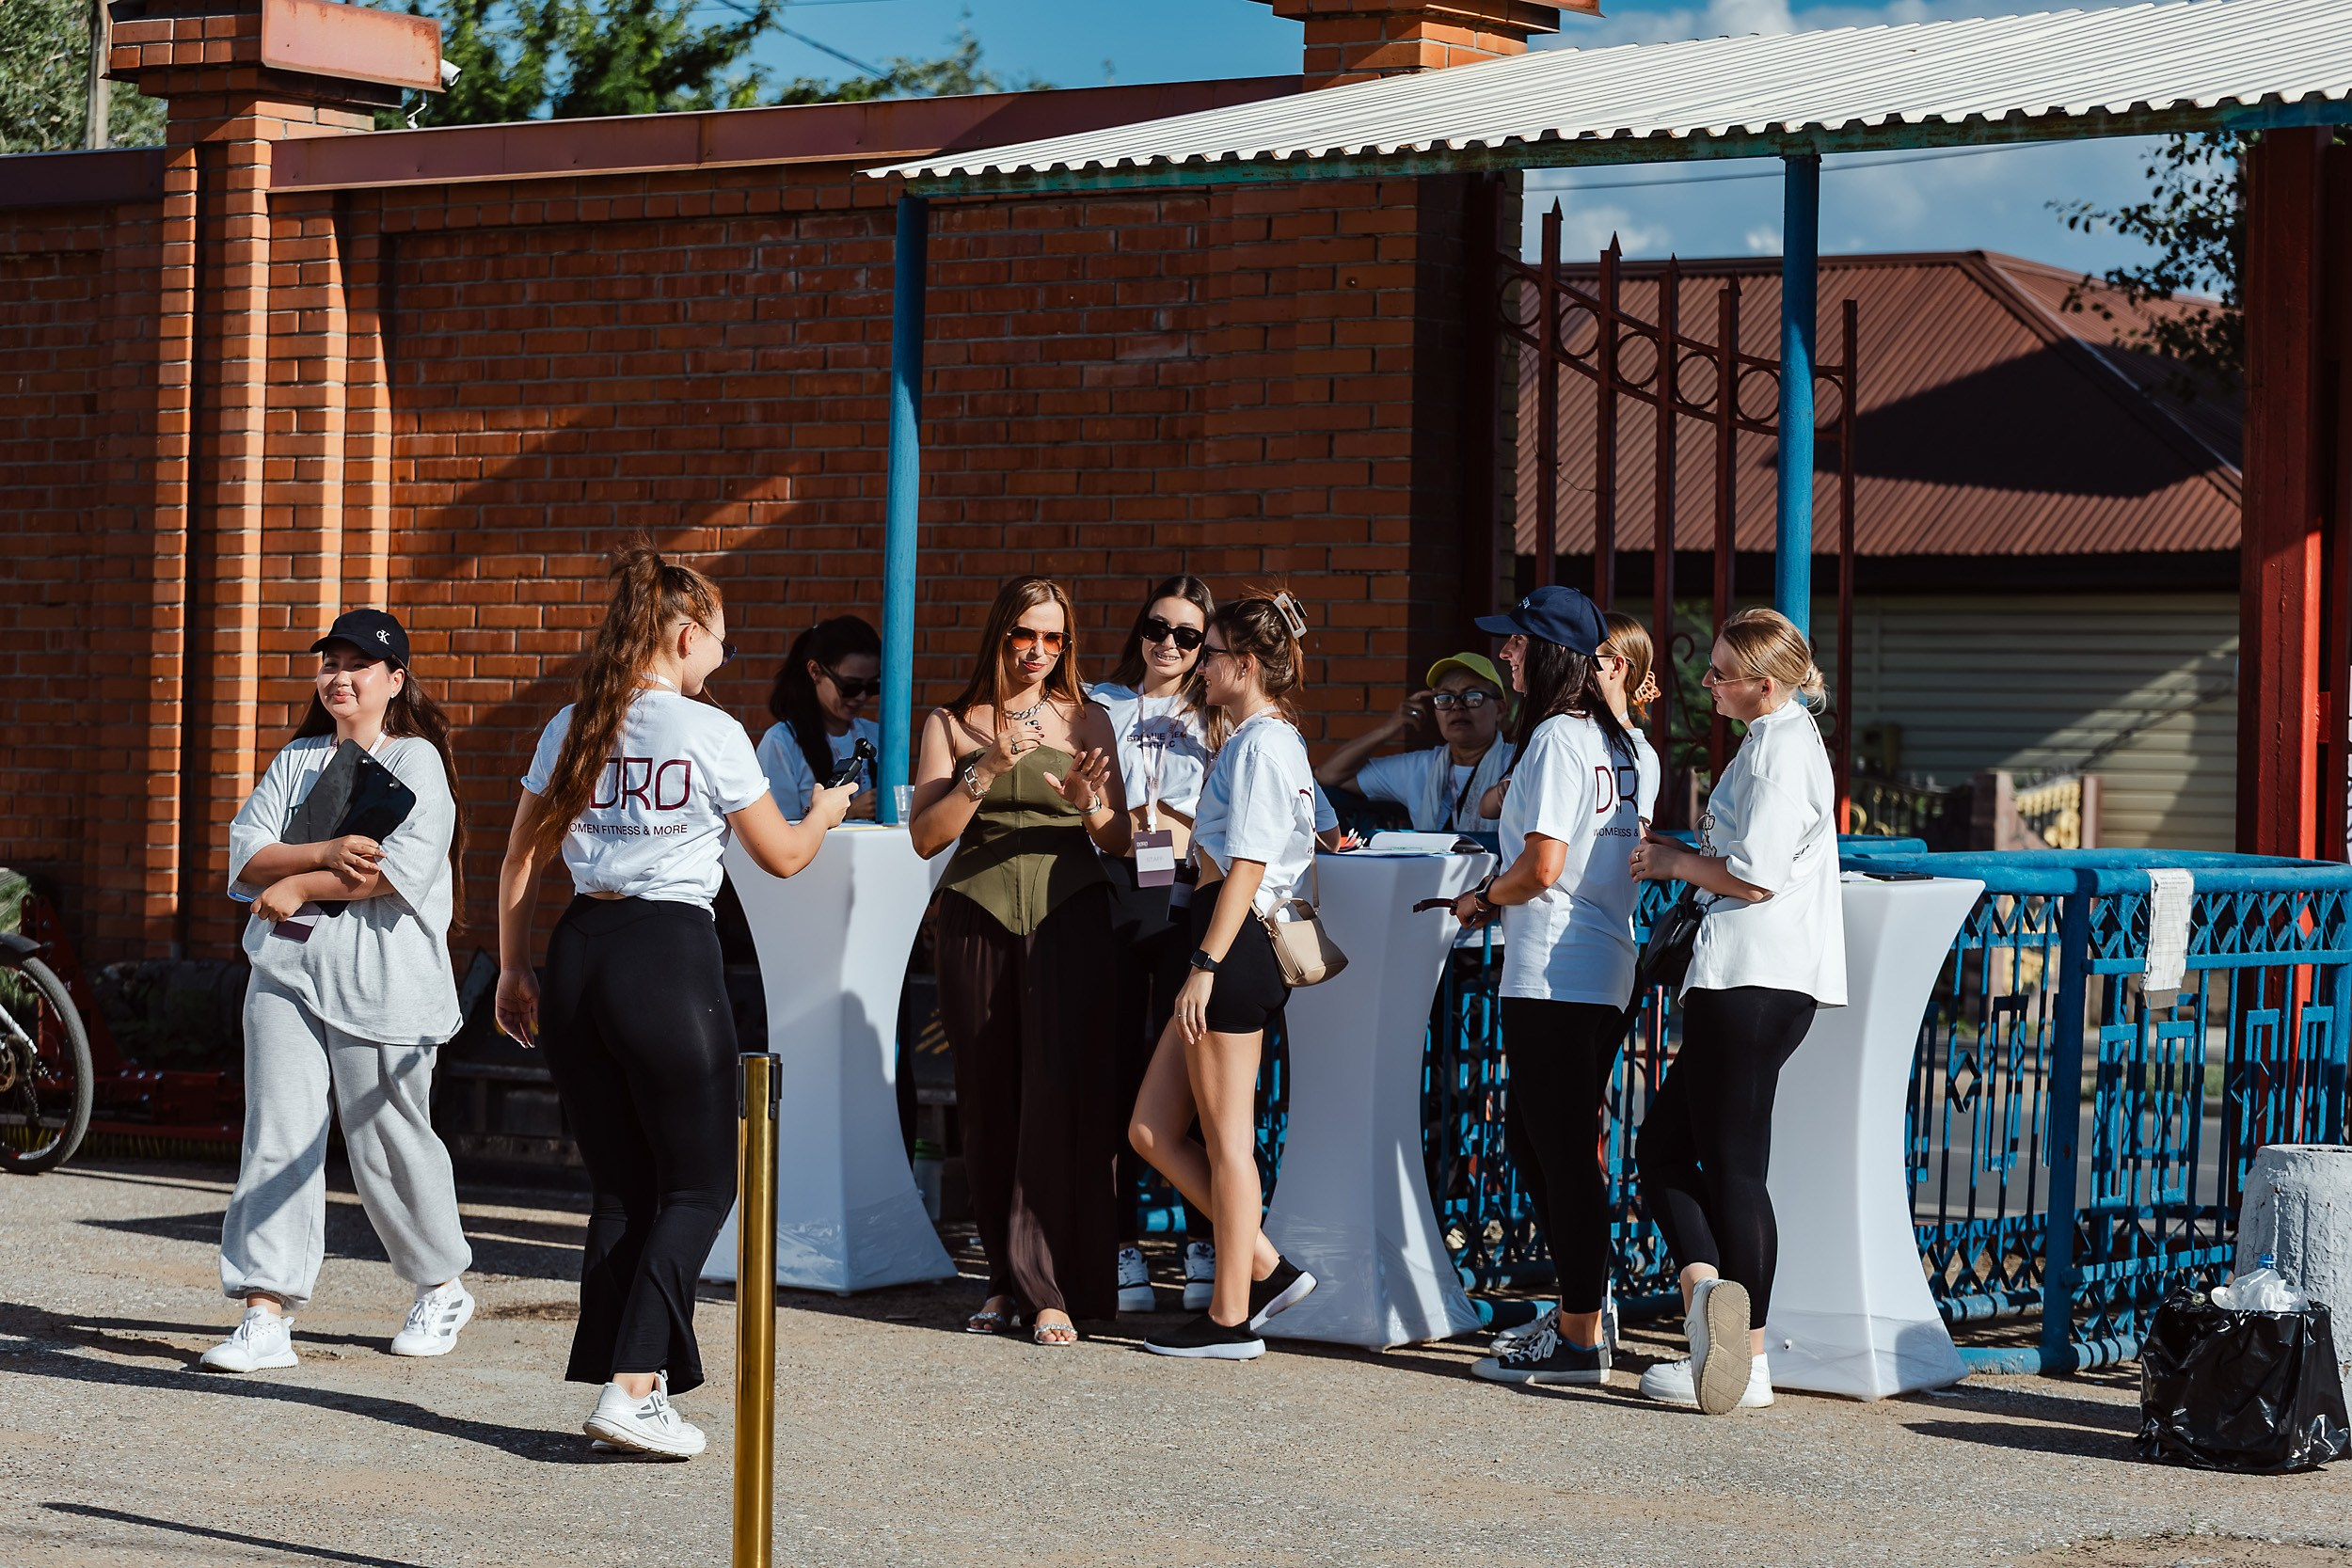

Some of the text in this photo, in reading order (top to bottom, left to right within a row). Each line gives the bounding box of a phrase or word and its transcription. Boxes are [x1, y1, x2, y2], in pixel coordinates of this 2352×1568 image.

[569, 823, 688, 836] OMEN FITNESS & MORE
